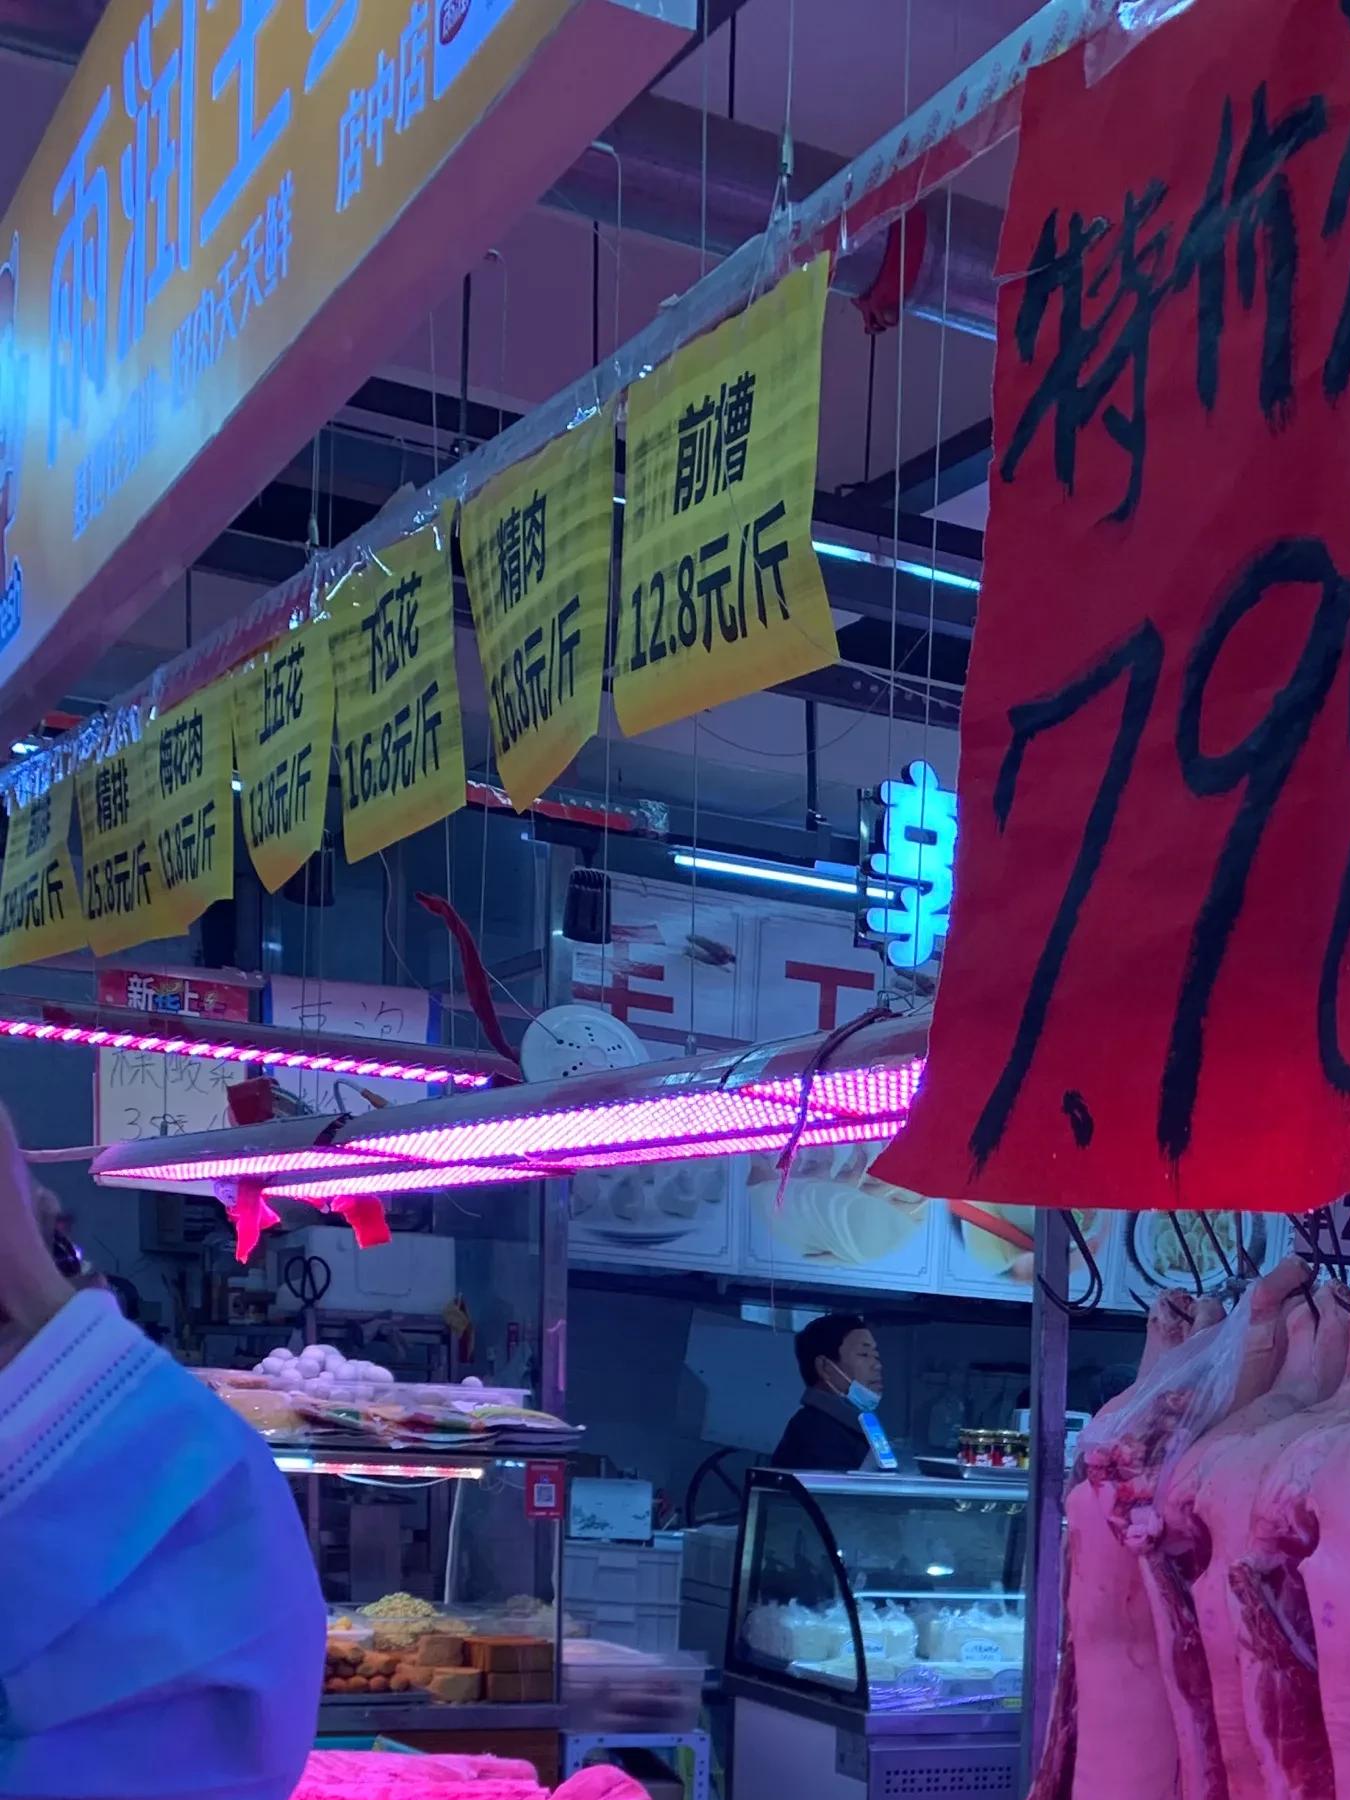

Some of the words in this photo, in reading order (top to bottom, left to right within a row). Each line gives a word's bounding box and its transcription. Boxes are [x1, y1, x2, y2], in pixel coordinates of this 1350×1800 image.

[335, 0, 429, 213] 店中店
[499, 489, 548, 613] 精肉
[630, 500, 790, 672] 12.8元/斤
[259, 641, 305, 745] 上五花
[361, 570, 423, 694] 下五花
[491, 595, 581, 754] 16.8元/斤
[96, 758, 130, 834] 精排
[159, 708, 203, 799] 梅花肉
[345, 681, 442, 811] 16.8元/斤
[86, 839, 152, 920] 25.8元/斤
